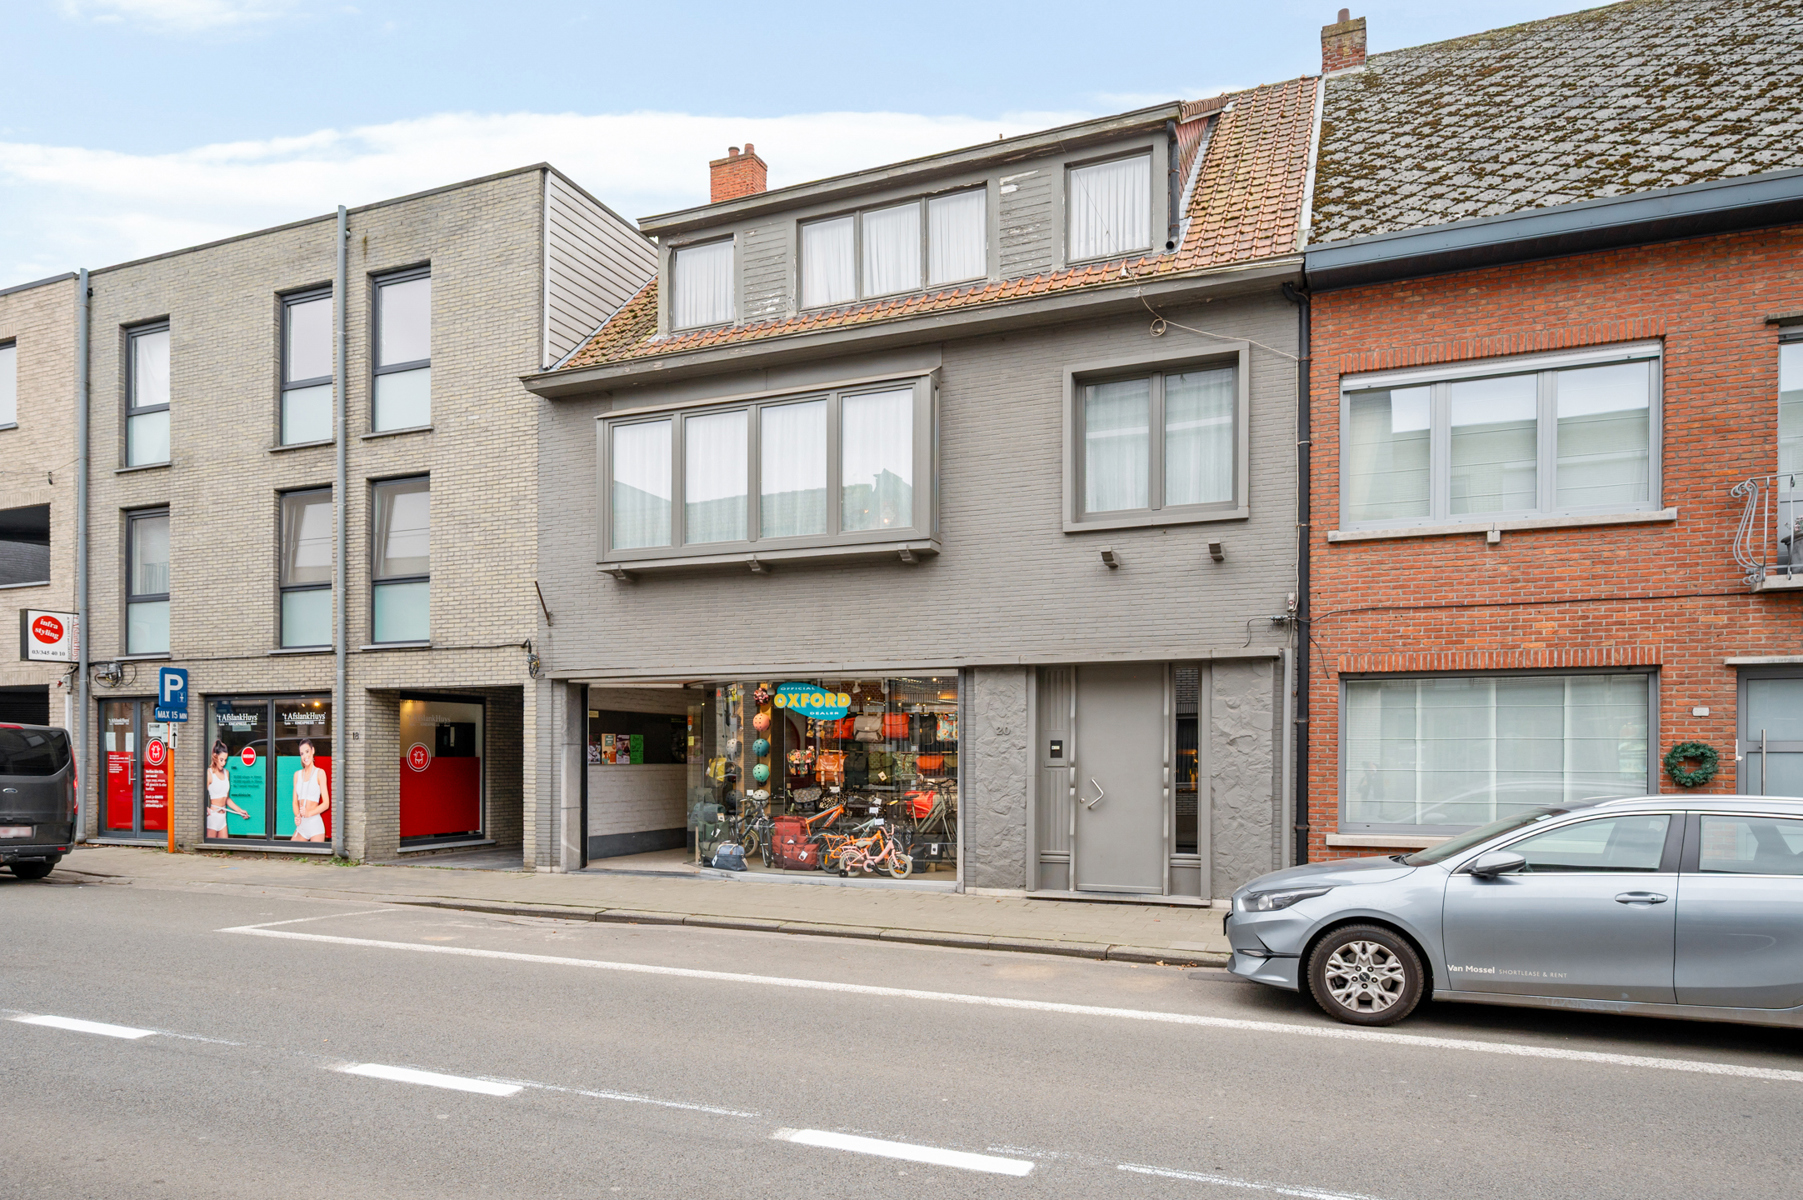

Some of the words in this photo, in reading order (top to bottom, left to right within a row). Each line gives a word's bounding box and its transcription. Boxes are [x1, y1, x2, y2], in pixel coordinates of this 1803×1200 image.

[40, 619, 58, 629] infra
[34, 627, 60, 640] styling
[164, 673, 184, 702] P
[774, 692, 852, 708] OXFORD
[157, 710, 170, 719] MAX
[171, 711, 178, 719] 15
[996, 727, 1011, 736] 20
[1447, 964, 1463, 972] Van
[1465, 965, 1495, 974] Mossel
[1499, 969, 1540, 977] SHORTLEASE
